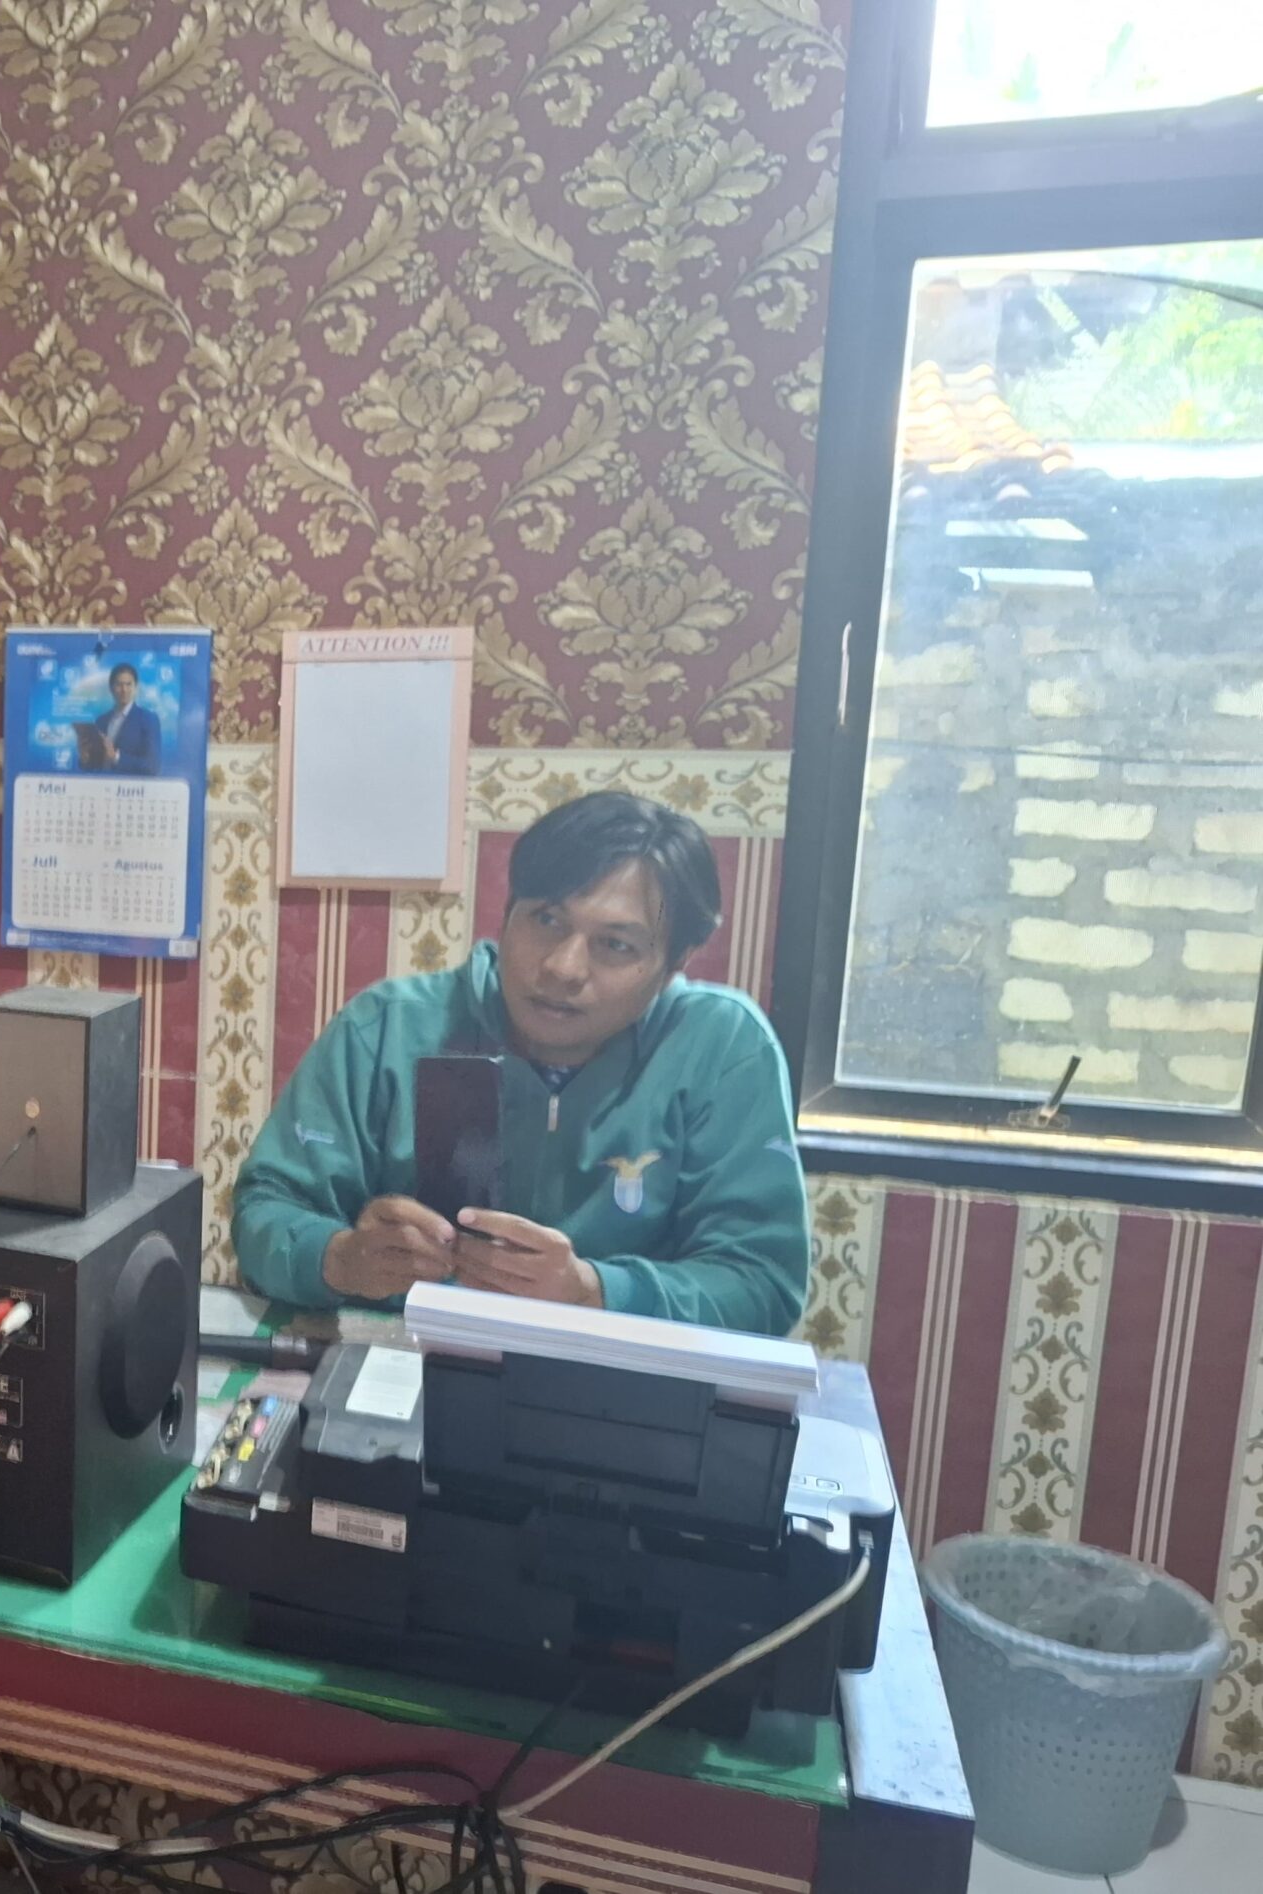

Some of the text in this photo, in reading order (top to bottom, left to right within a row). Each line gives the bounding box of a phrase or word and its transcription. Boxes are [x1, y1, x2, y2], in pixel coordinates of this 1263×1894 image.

[301, 633, 450, 653] ATTENTION !!!
[38, 782, 66, 795] Mei
[116, 785, 145, 798] Juni
[33, 855, 58, 868] Juli
[114, 859, 163, 873] Agustus
